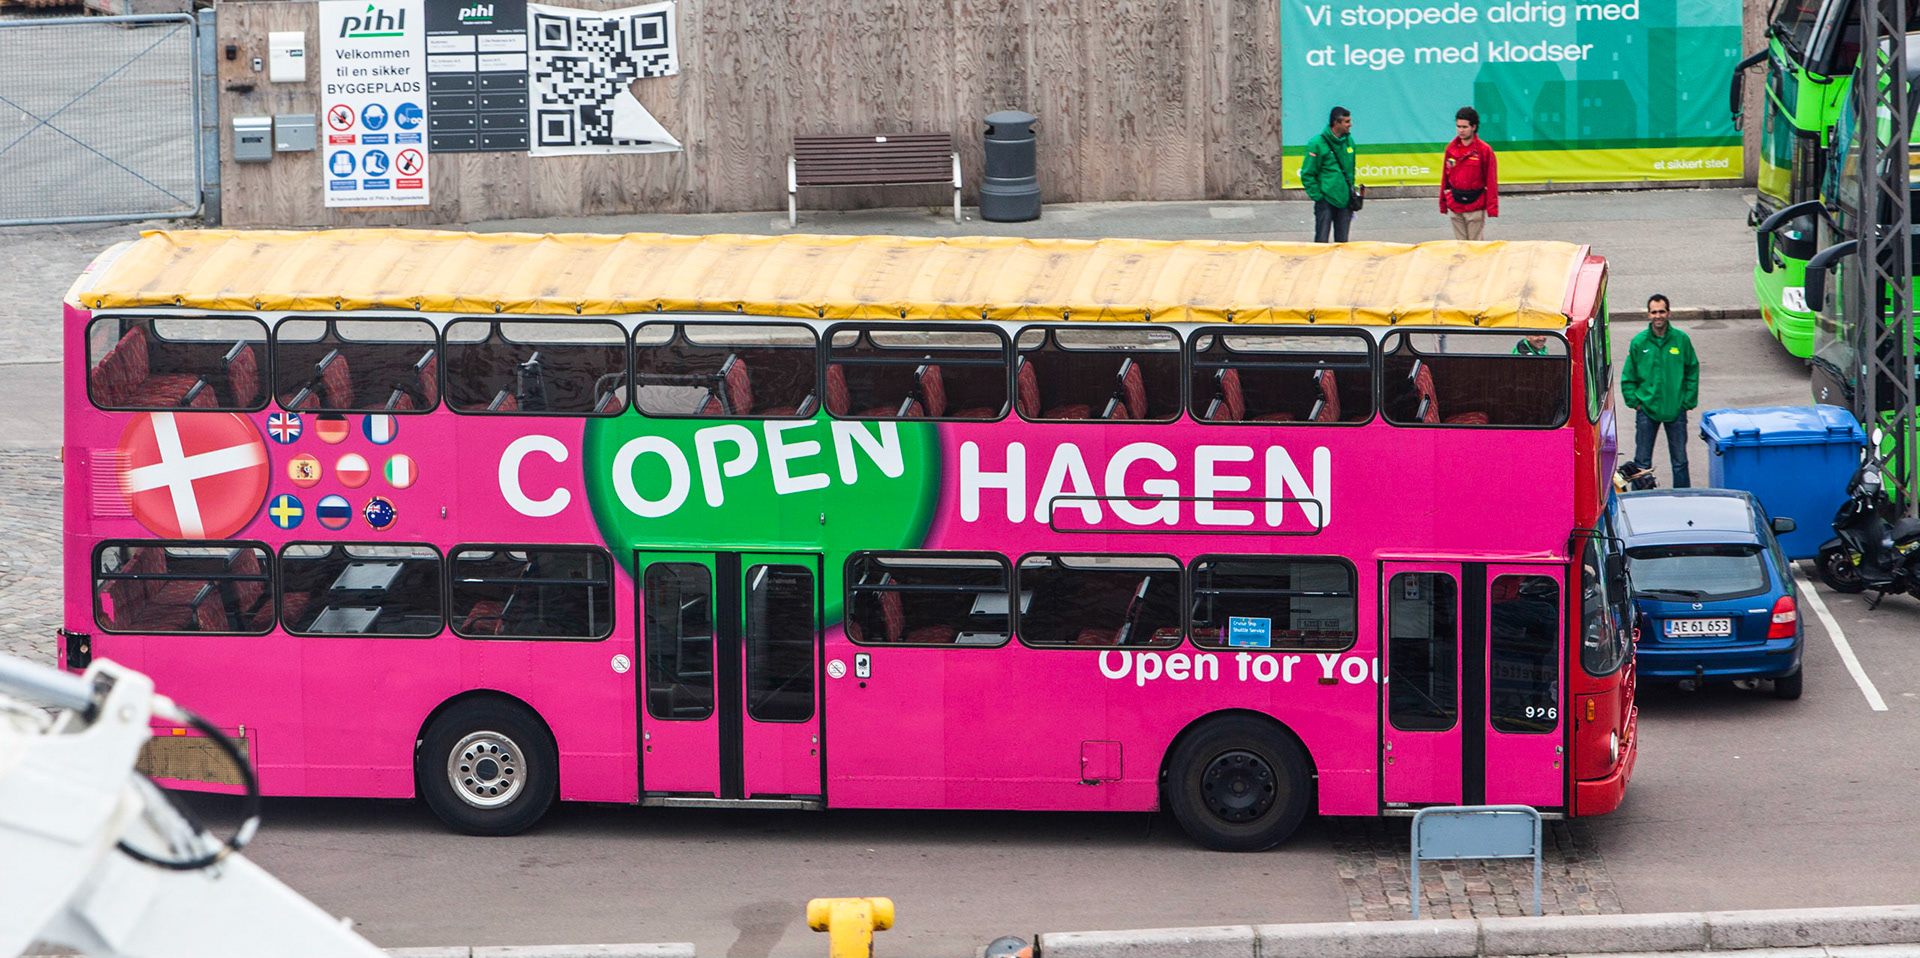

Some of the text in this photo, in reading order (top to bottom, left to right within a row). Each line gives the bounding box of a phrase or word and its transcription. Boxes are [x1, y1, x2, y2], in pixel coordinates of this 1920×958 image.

[457, 2, 494, 20] pihl
[1306, 0, 1640, 30] Vi stoppede aldrig med
[339, 4, 406, 38] pihl
[335, 48, 410, 60] Velkommen
[1306, 40, 1593, 71] at lege med klodser
[336, 65, 411, 77] til en sikker
[327, 81, 421, 95] BYGGEPLADS
[1653, 157, 1729, 170] et sikkert sted
[498, 420, 1332, 528] C OPEN HAGEN
[1673, 620, 1729, 633] AE 61 653
[1098, 650, 1219, 687] Open
[1525, 706, 1558, 720] 926
